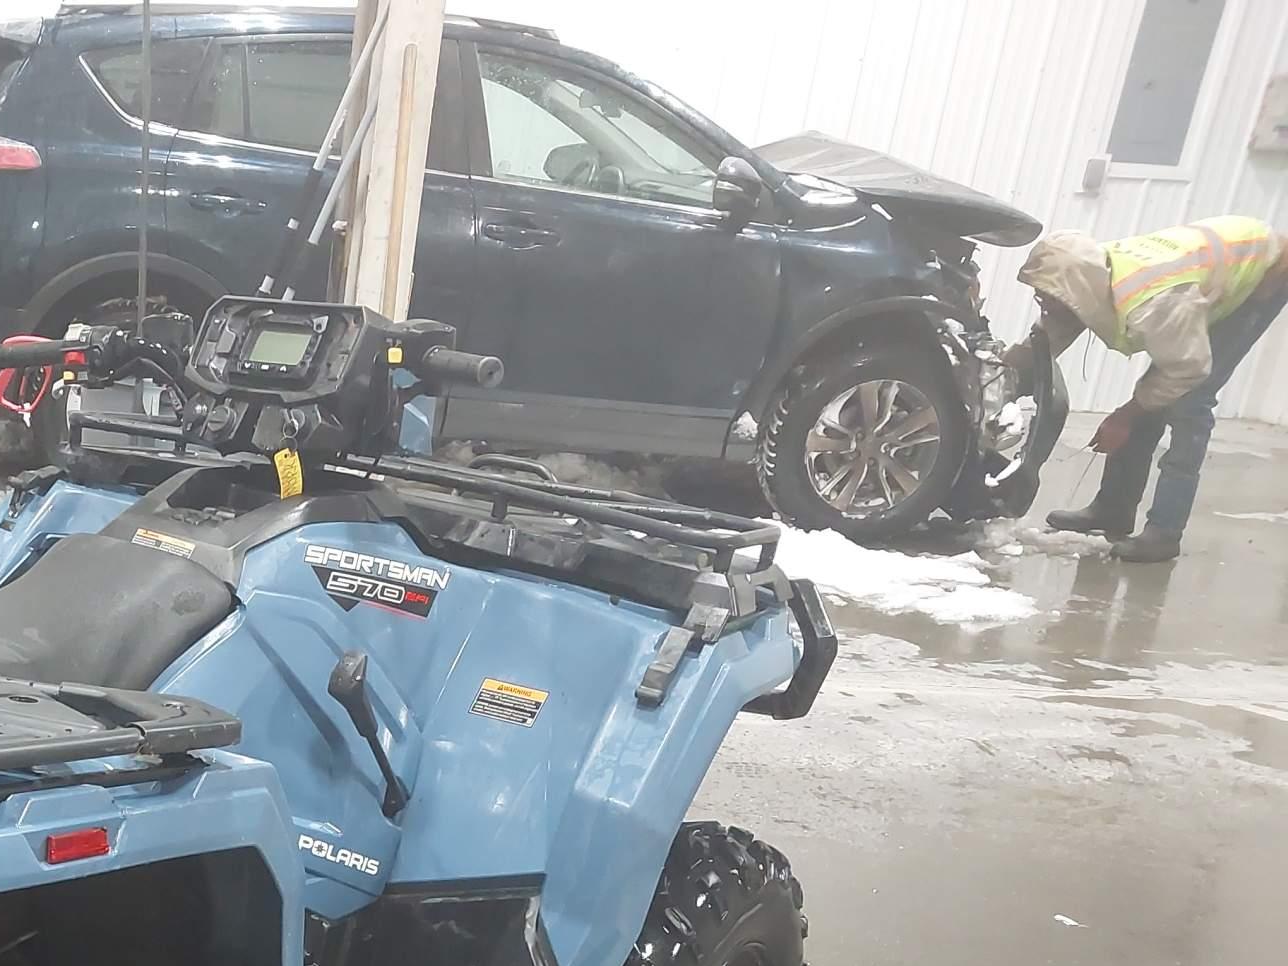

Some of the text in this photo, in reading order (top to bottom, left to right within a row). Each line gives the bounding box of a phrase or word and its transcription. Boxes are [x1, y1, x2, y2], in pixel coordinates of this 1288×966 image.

[304, 544, 451, 590] SPORTSMAN
[326, 571, 406, 604] 570
[503, 686, 532, 697] WARNING
[298, 834, 380, 875] POLARIS
